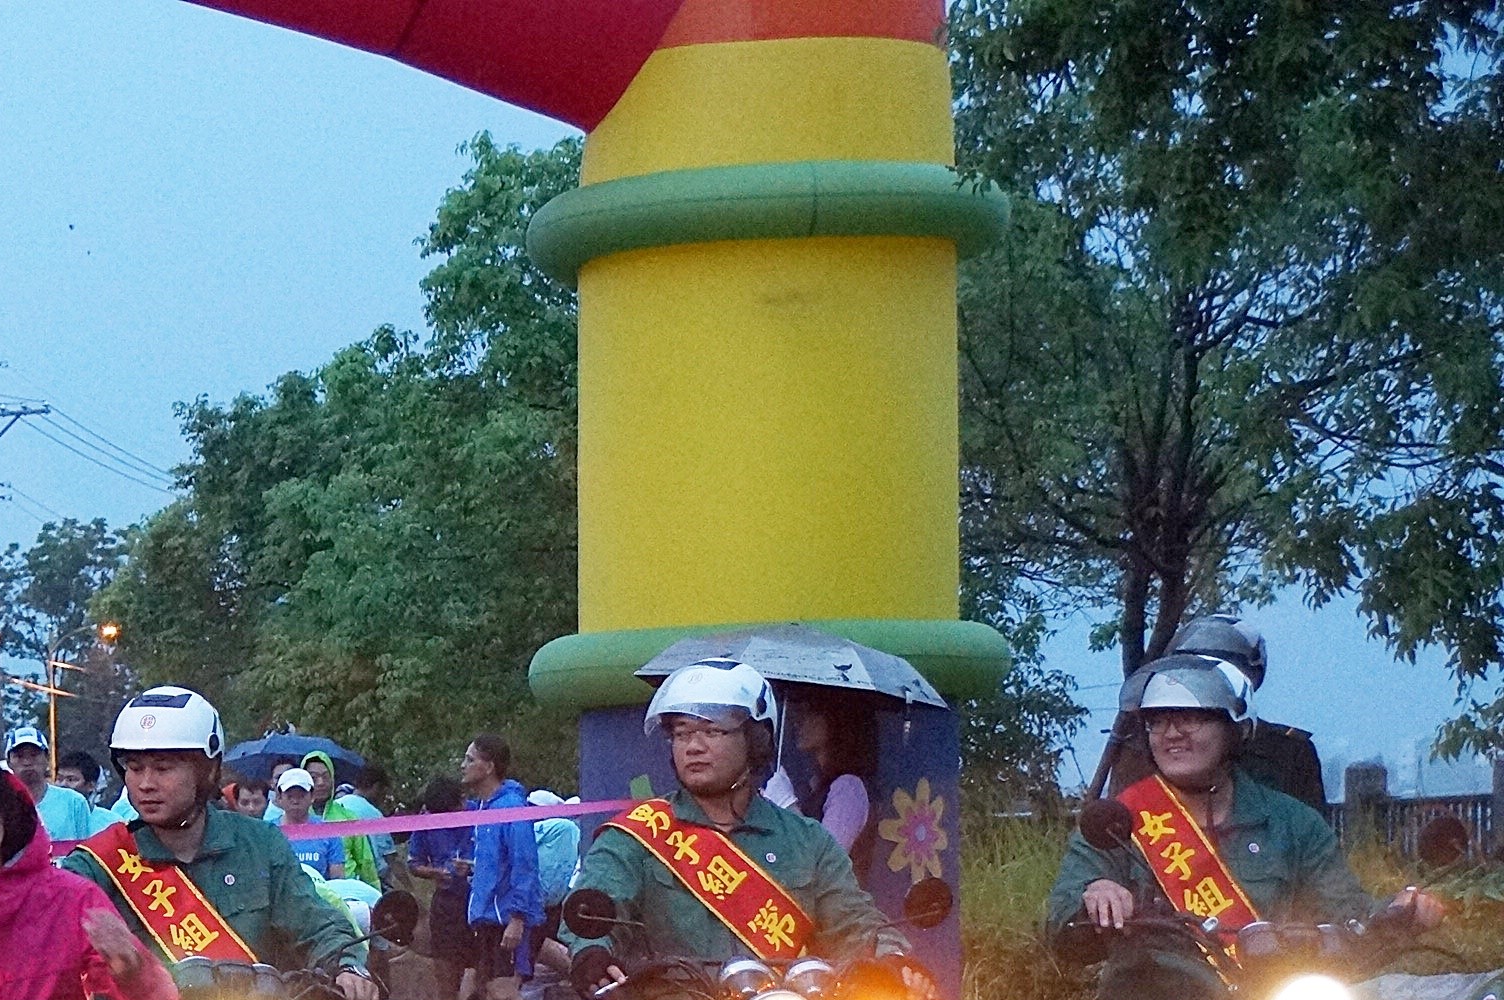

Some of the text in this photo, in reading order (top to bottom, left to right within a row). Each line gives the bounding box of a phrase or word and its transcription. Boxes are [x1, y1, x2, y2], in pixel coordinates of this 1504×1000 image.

[116, 848, 220, 957] 女子組
[626, 803, 748, 900] 男子組
[1138, 810, 1234, 918] 女子組
